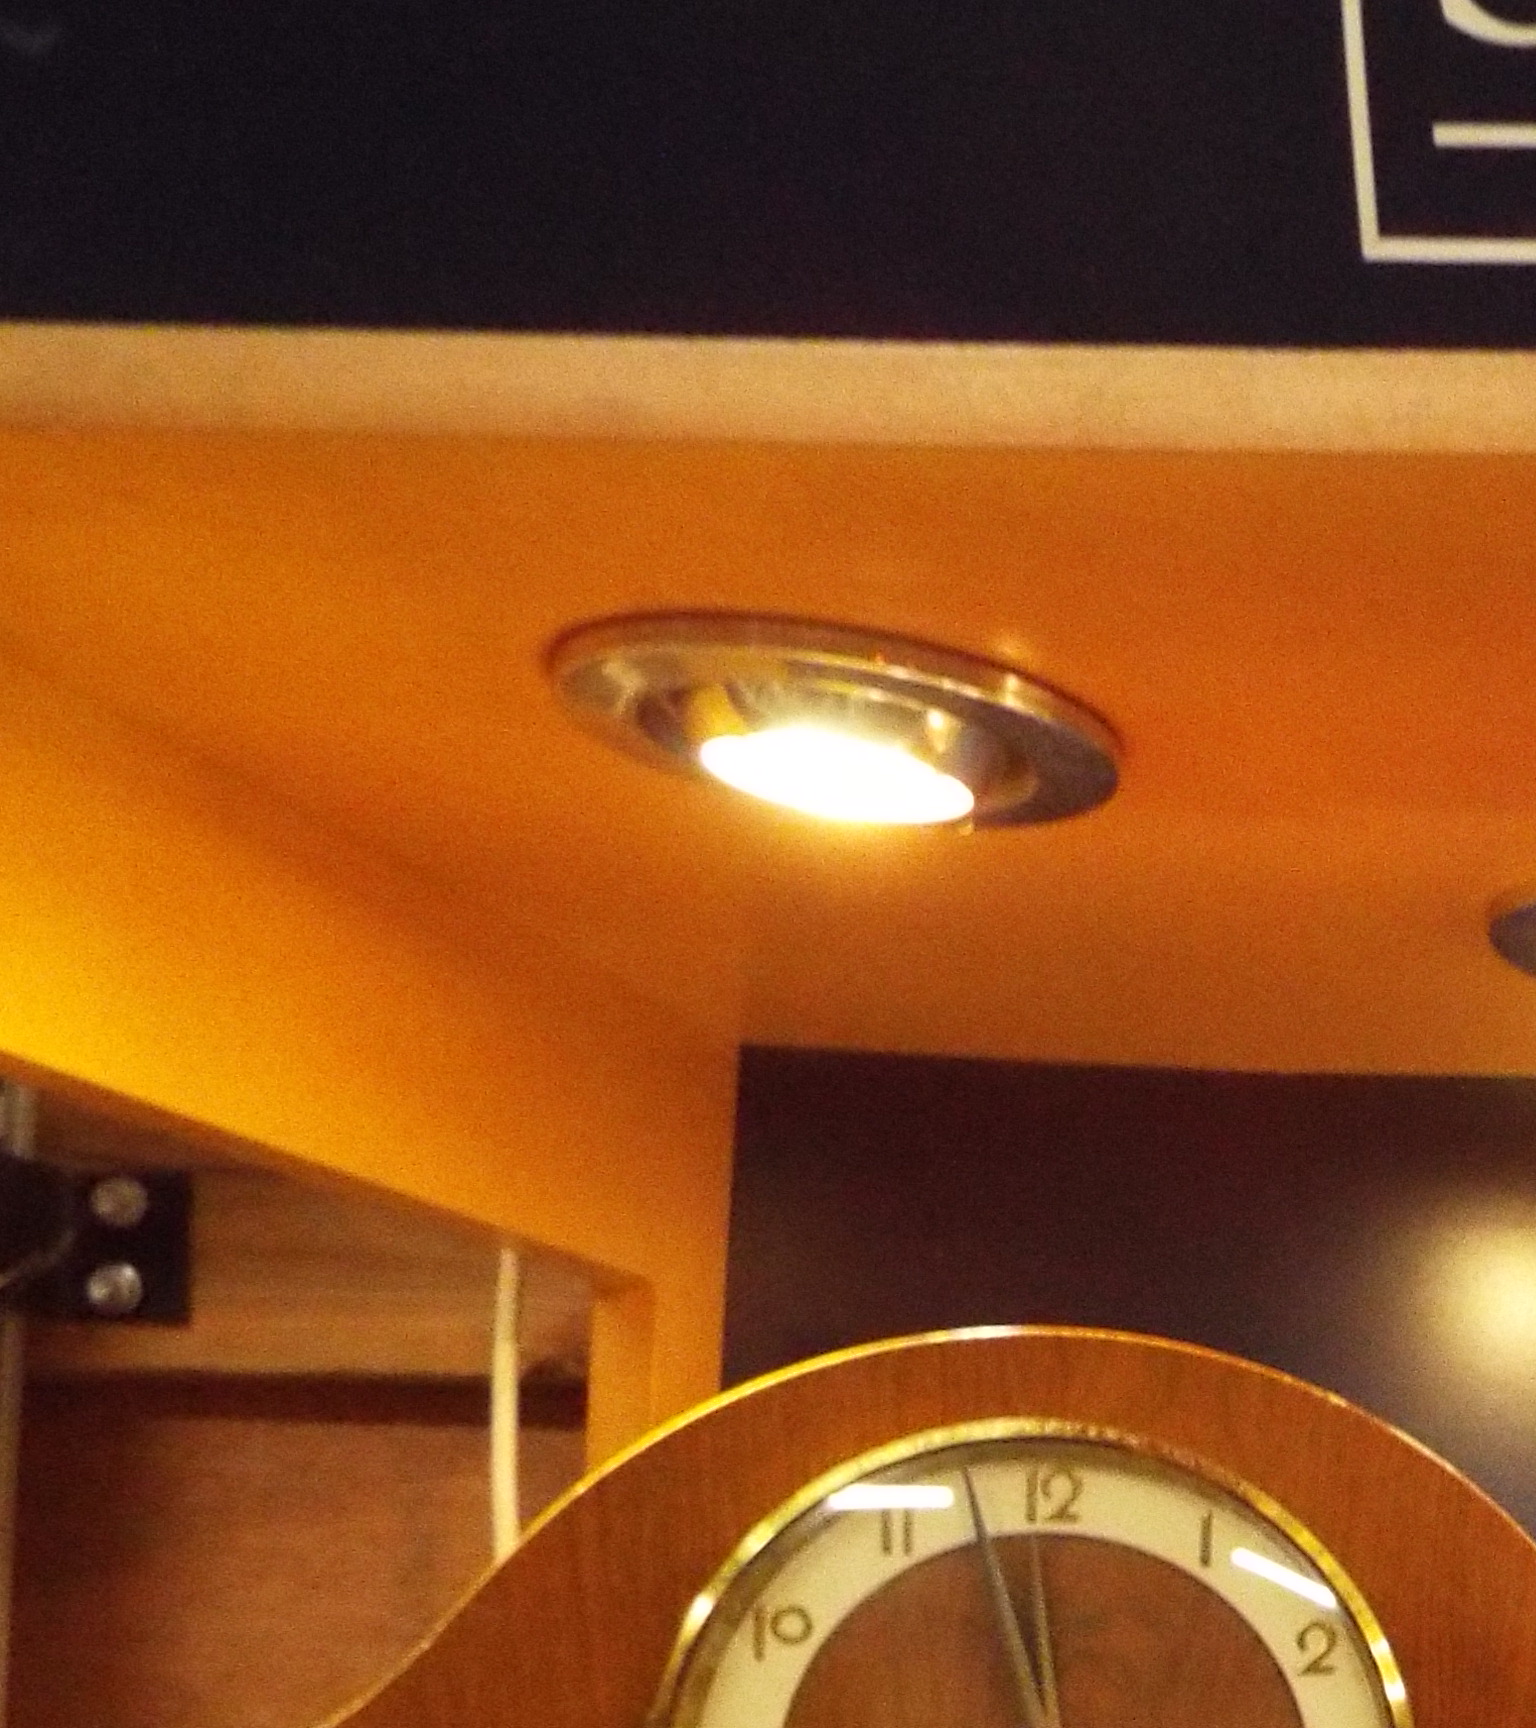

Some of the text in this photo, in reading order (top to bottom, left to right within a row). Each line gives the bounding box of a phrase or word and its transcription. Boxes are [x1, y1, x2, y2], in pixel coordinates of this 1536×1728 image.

[1025, 1465, 1084, 1523] 12
[880, 1503, 914, 1556] 11
[1198, 1508, 1214, 1569] 1
[752, 1604, 814, 1662] 10
[1296, 1621, 1339, 1677] 2
